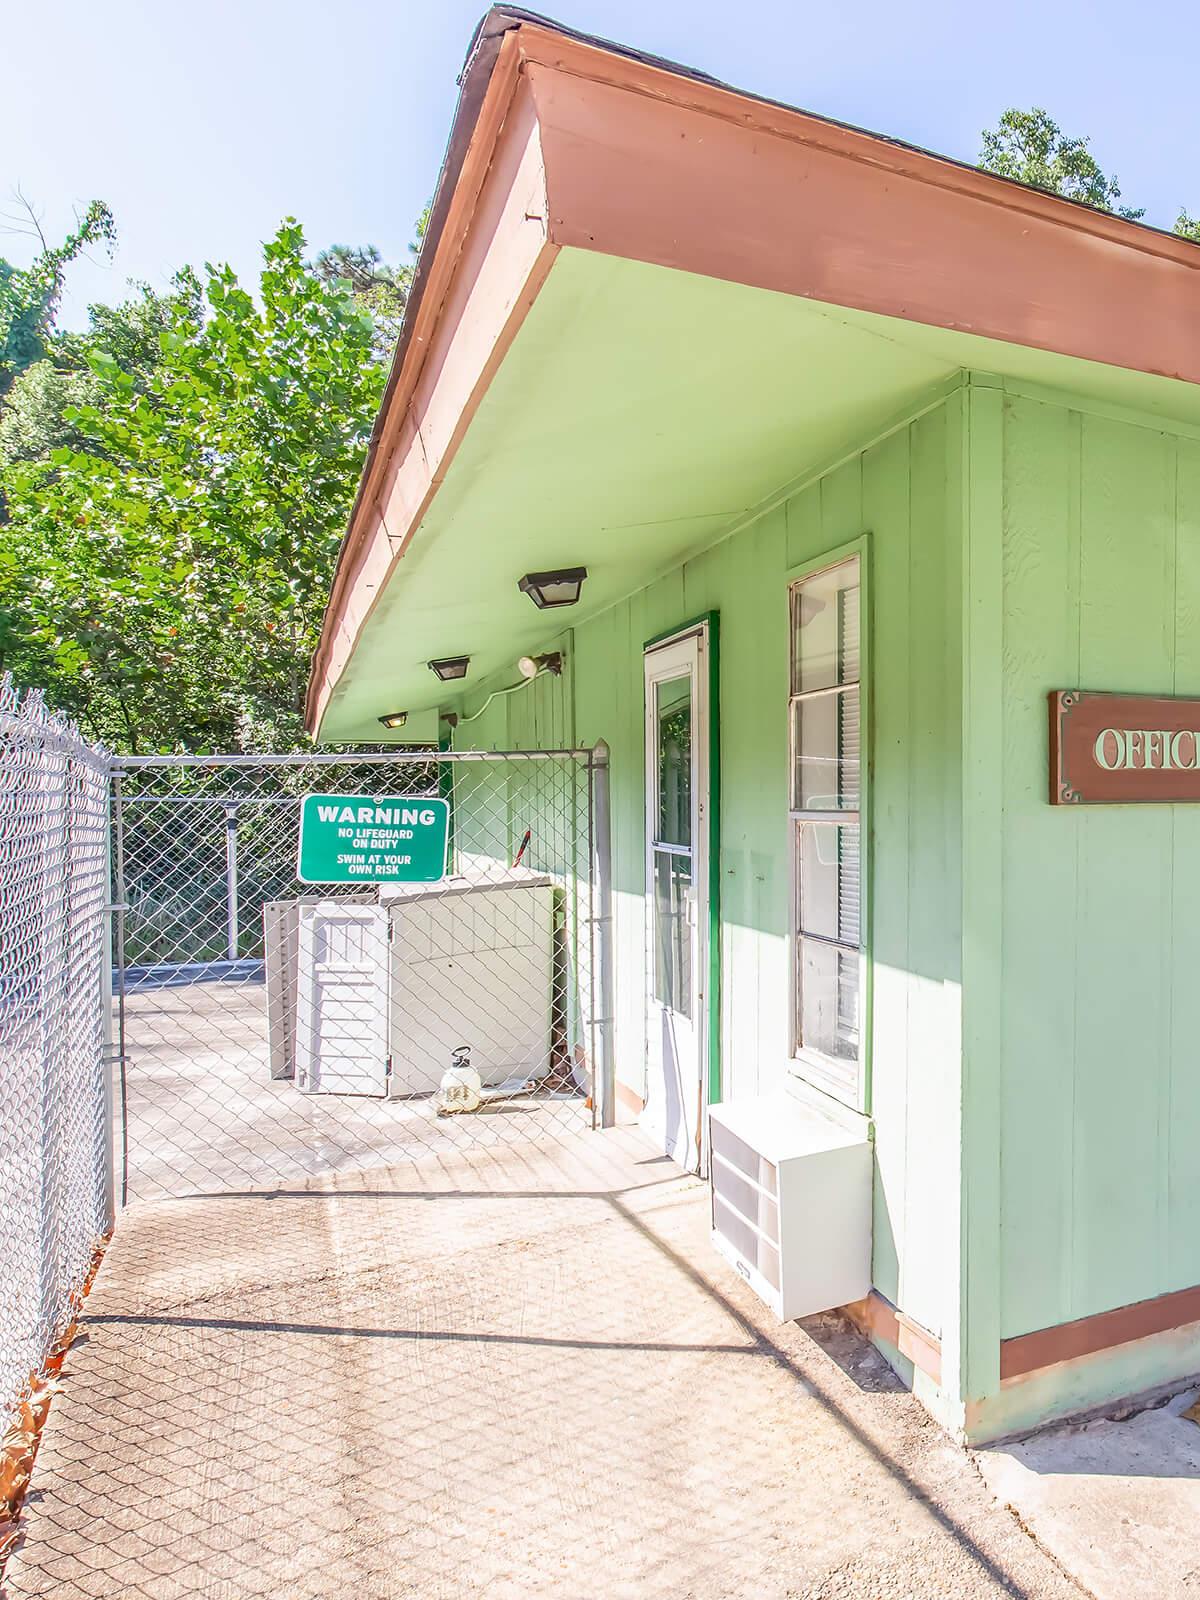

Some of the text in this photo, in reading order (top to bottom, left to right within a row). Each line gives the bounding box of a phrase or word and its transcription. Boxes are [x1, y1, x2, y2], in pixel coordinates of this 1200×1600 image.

[317, 806, 436, 826] WARNING
[338, 828, 413, 839] NO LIFEGUARD
[352, 839, 398, 849] ON DUTY
[337, 854, 411, 865] SWIM AT YOUR
[348, 865, 399, 875] OWN RISK
